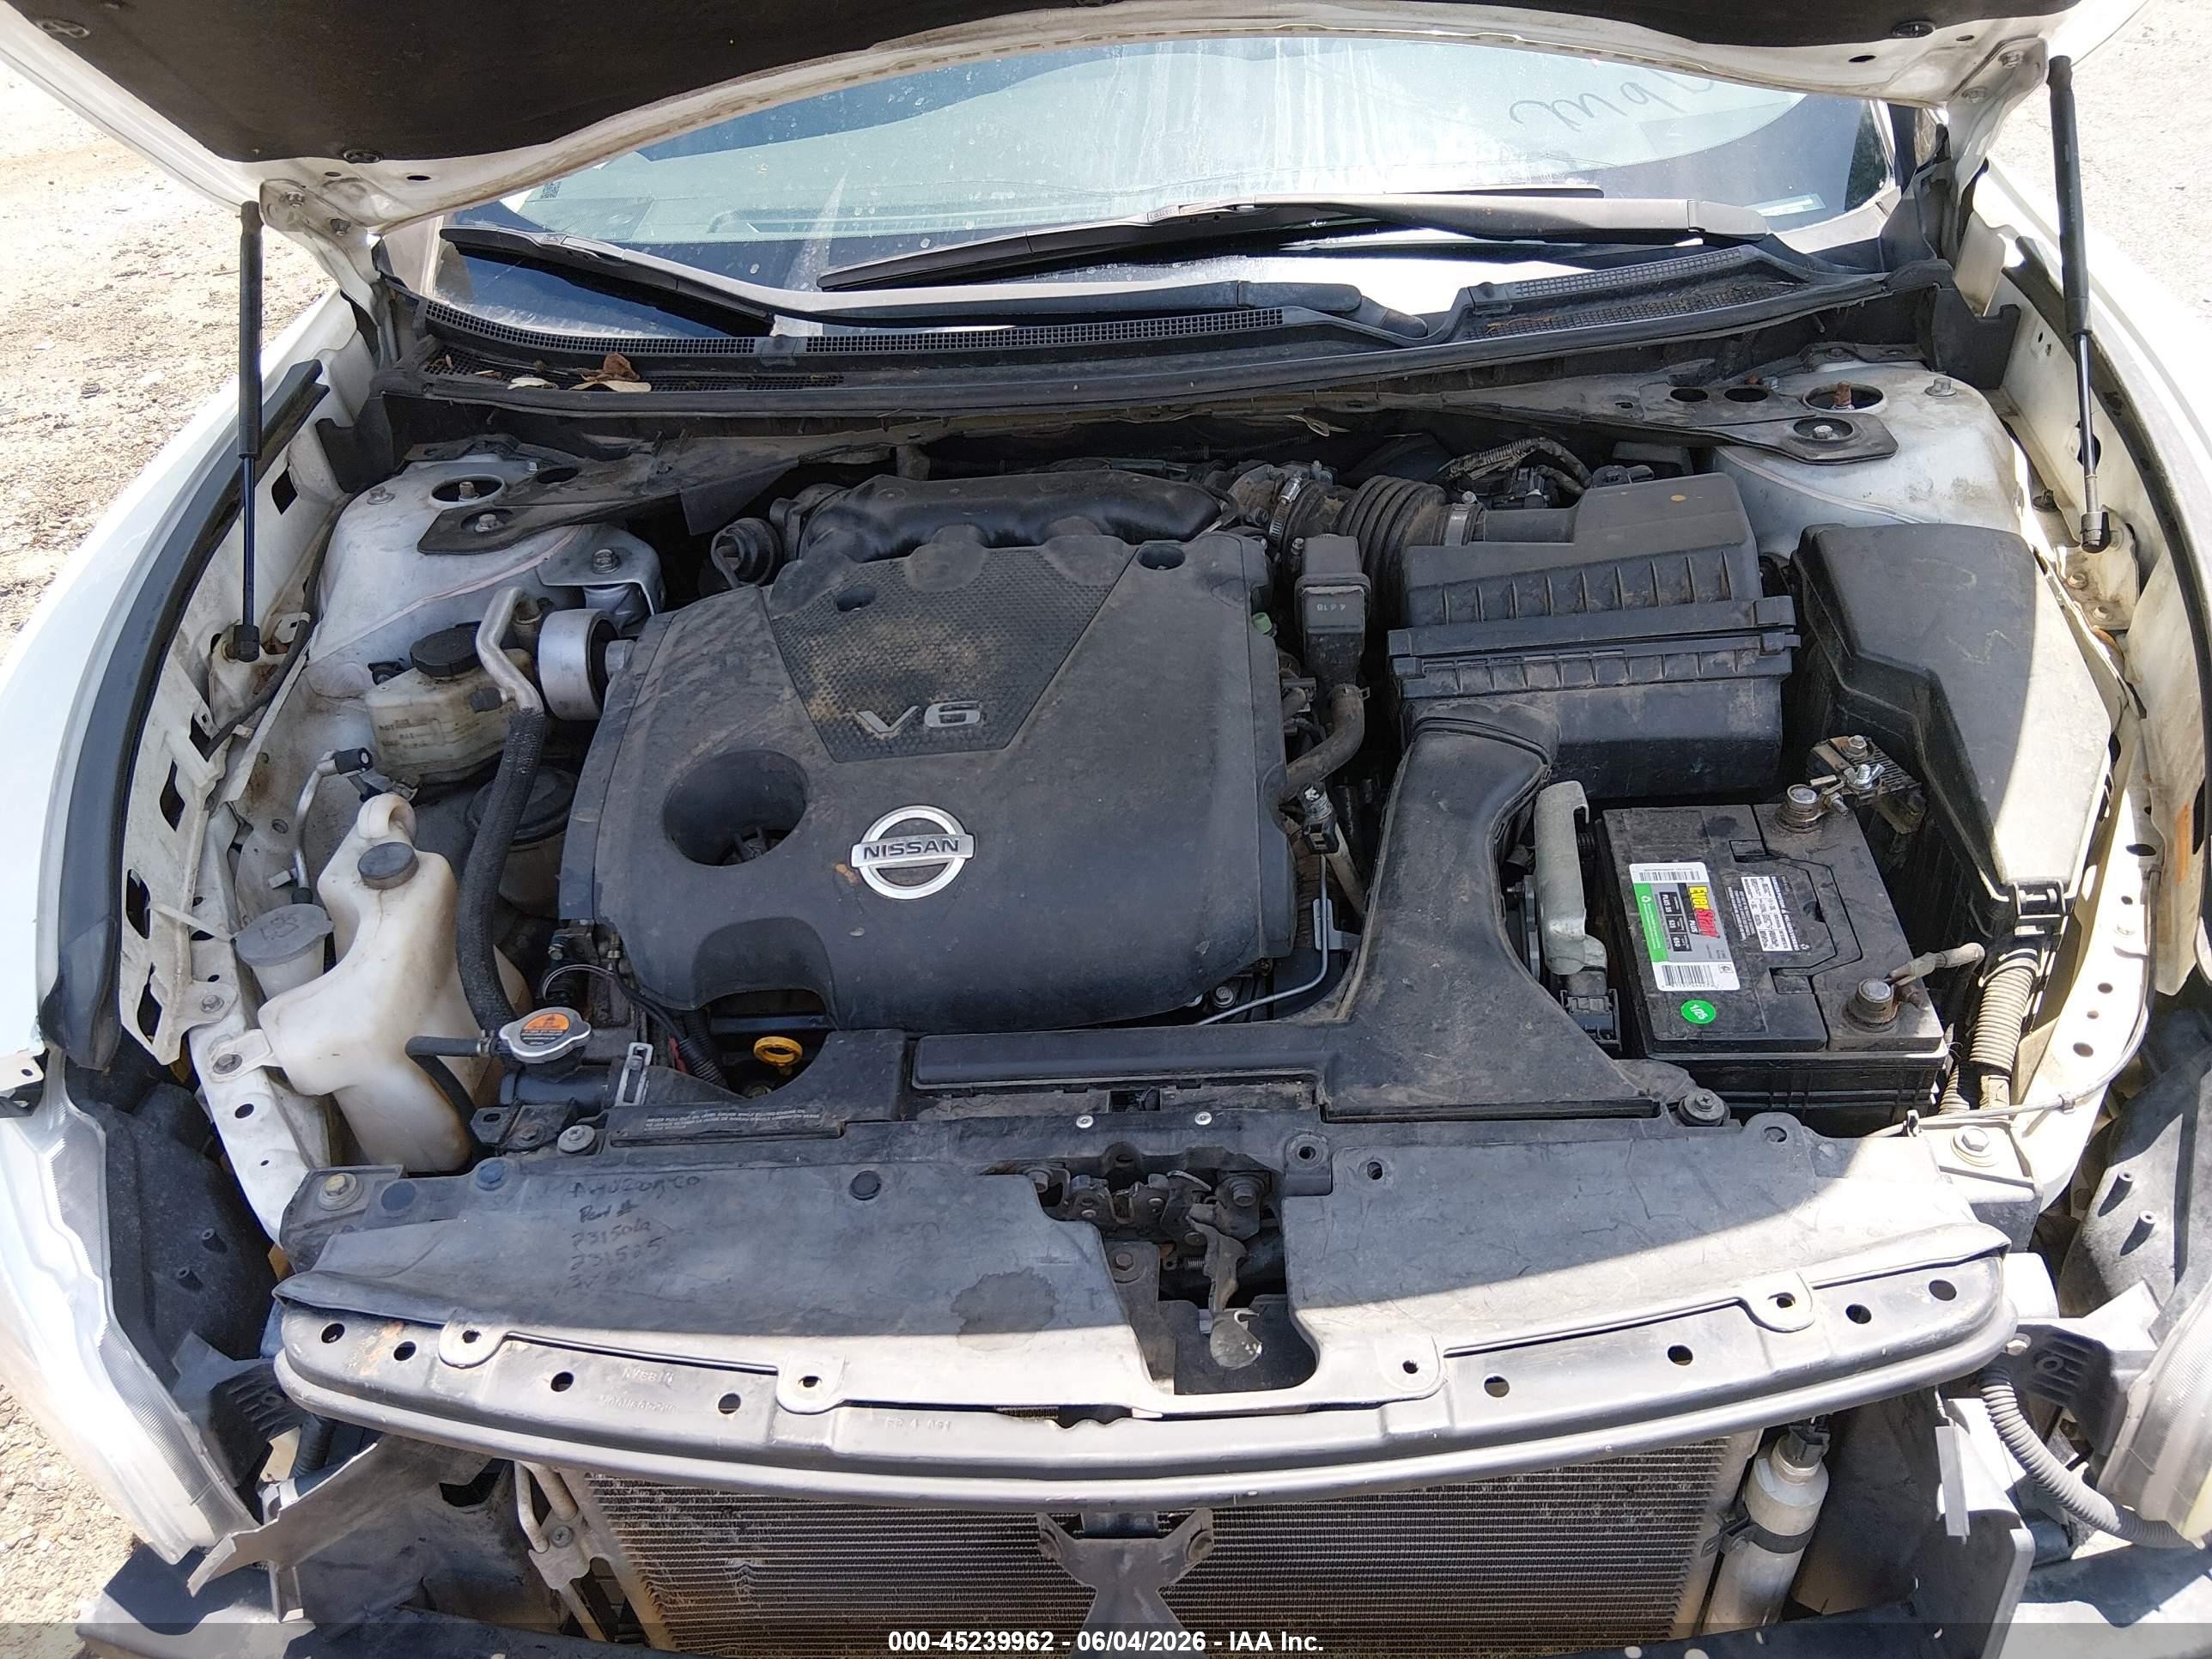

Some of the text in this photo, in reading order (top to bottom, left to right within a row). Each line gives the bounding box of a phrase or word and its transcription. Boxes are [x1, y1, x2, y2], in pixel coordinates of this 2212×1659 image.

[857, 700, 982, 734] V6
[864, 837, 959, 860] NISSAN
[1688, 885, 1720, 938] EverStart
[1688, 919, 1698, 933] PLUS
[1689, 1004, 1709, 1020] 1/25
